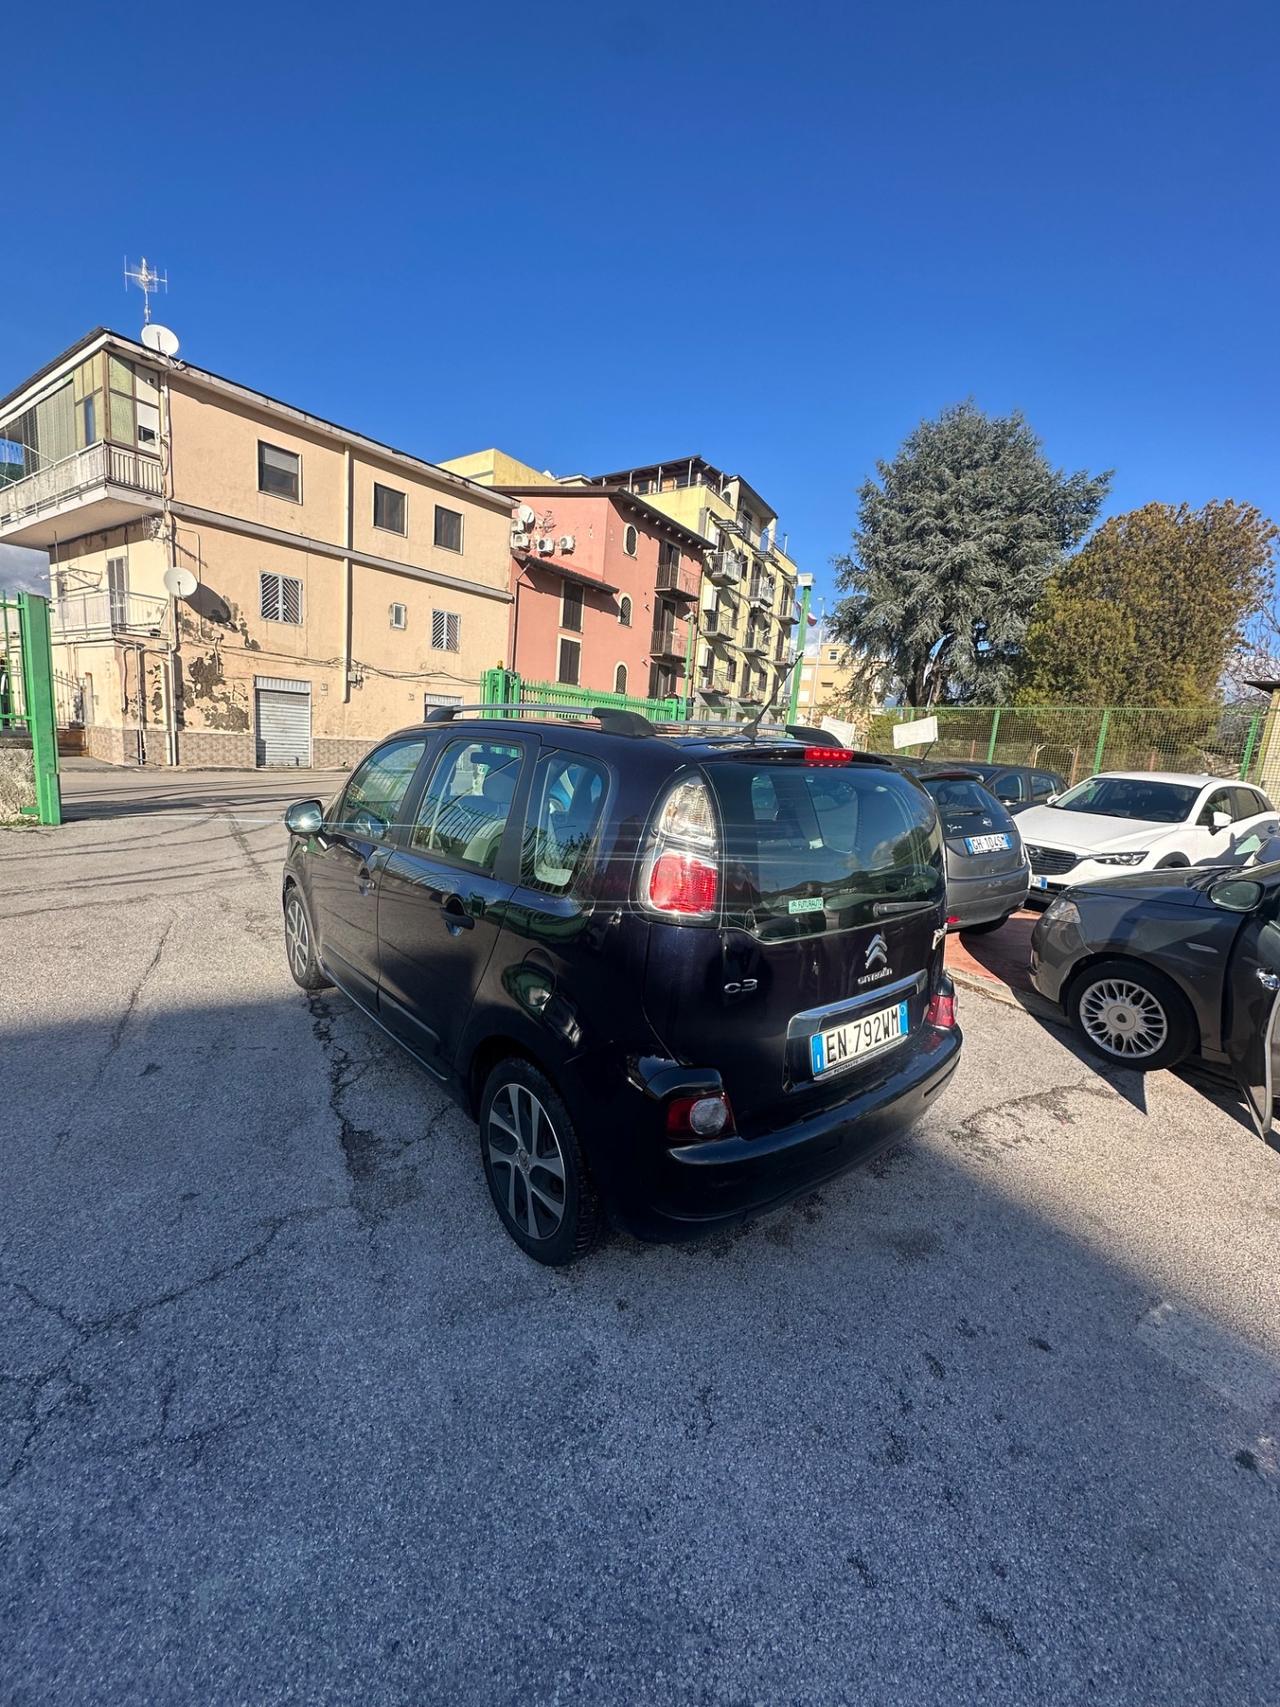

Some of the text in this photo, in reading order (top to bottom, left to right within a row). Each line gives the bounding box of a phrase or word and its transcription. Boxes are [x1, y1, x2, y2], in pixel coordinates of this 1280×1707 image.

[724, 979, 757, 993] C3
[826, 1028, 848, 1064] EN
[853, 1006, 900, 1054] 792WM
